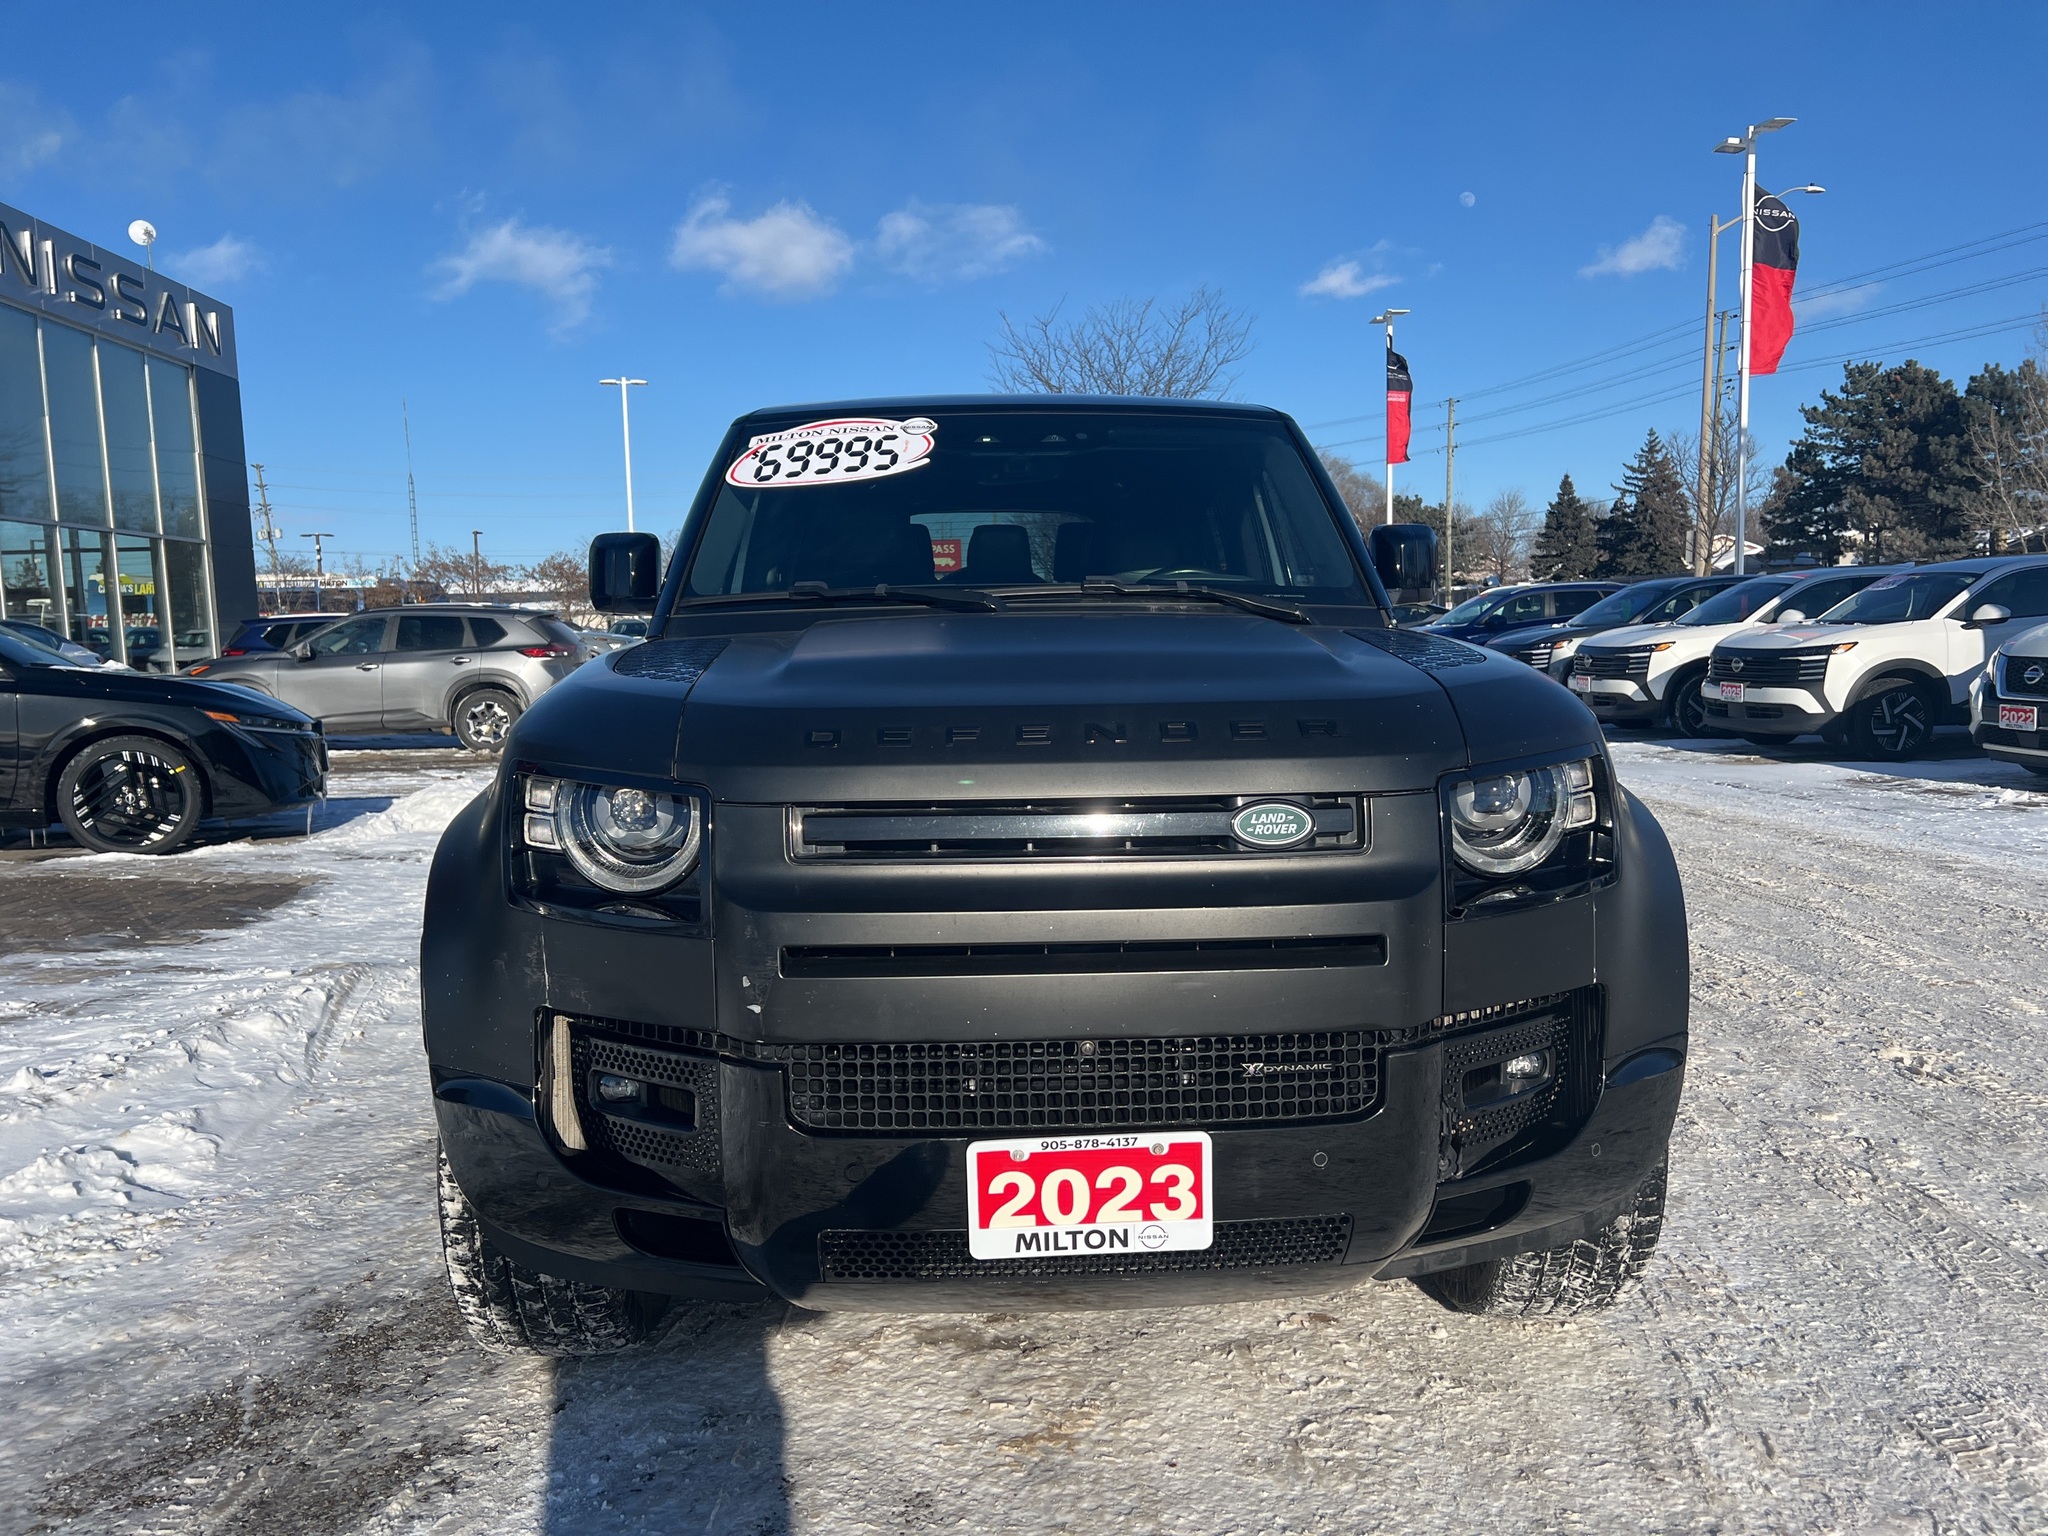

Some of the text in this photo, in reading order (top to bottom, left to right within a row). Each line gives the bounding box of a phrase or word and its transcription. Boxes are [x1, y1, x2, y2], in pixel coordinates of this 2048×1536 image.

[1753, 208, 1796, 219] NISSAN
[0, 221, 221, 356] NISSAN
[756, 425, 896, 445] MILTON NISSAN
[2002, 710, 2034, 725] 2022
[804, 709, 1343, 748] DEFENDER
[1264, 1063, 1332, 1073] DYNAMIC
[1041, 1137, 1138, 1151] 905-878-4137
[988, 1163, 1197, 1229] 2023
[1015, 1228, 1129, 1252] MILTON
